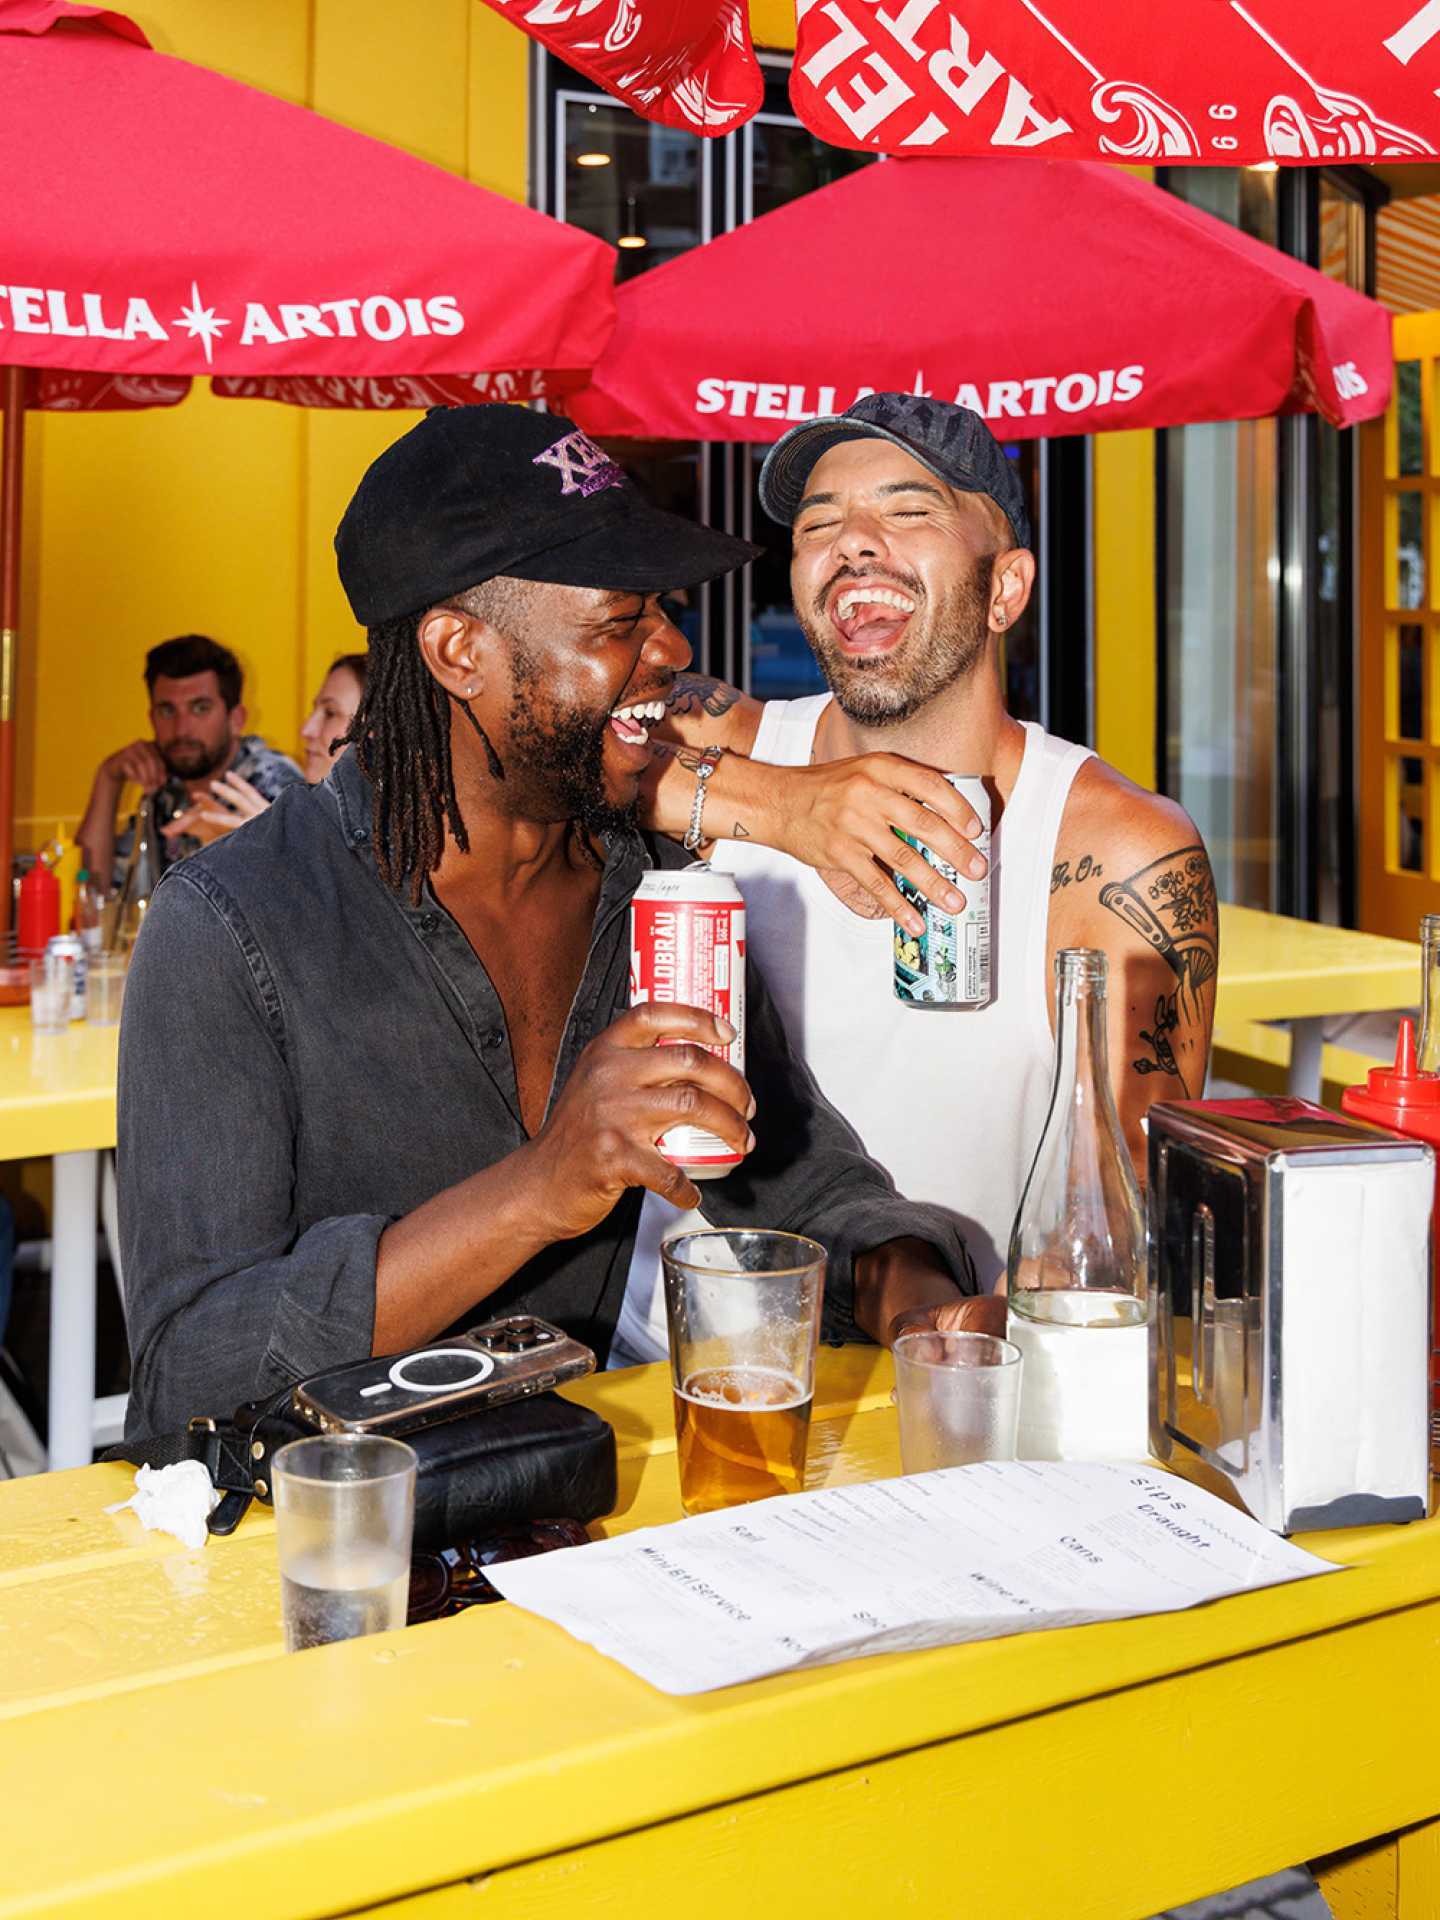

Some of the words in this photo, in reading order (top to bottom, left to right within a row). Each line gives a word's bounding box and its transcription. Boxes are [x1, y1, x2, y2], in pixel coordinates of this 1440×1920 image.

[240, 296, 464, 345] ARTOIS
[955, 365, 1145, 419] ARTOIS
[649, 912, 675, 1002] OLDBRÄU
[1059, 1535, 1103, 1564] Cans
[1137, 1503, 1211, 1549] Draught
[692, 1581, 751, 1622] Service
